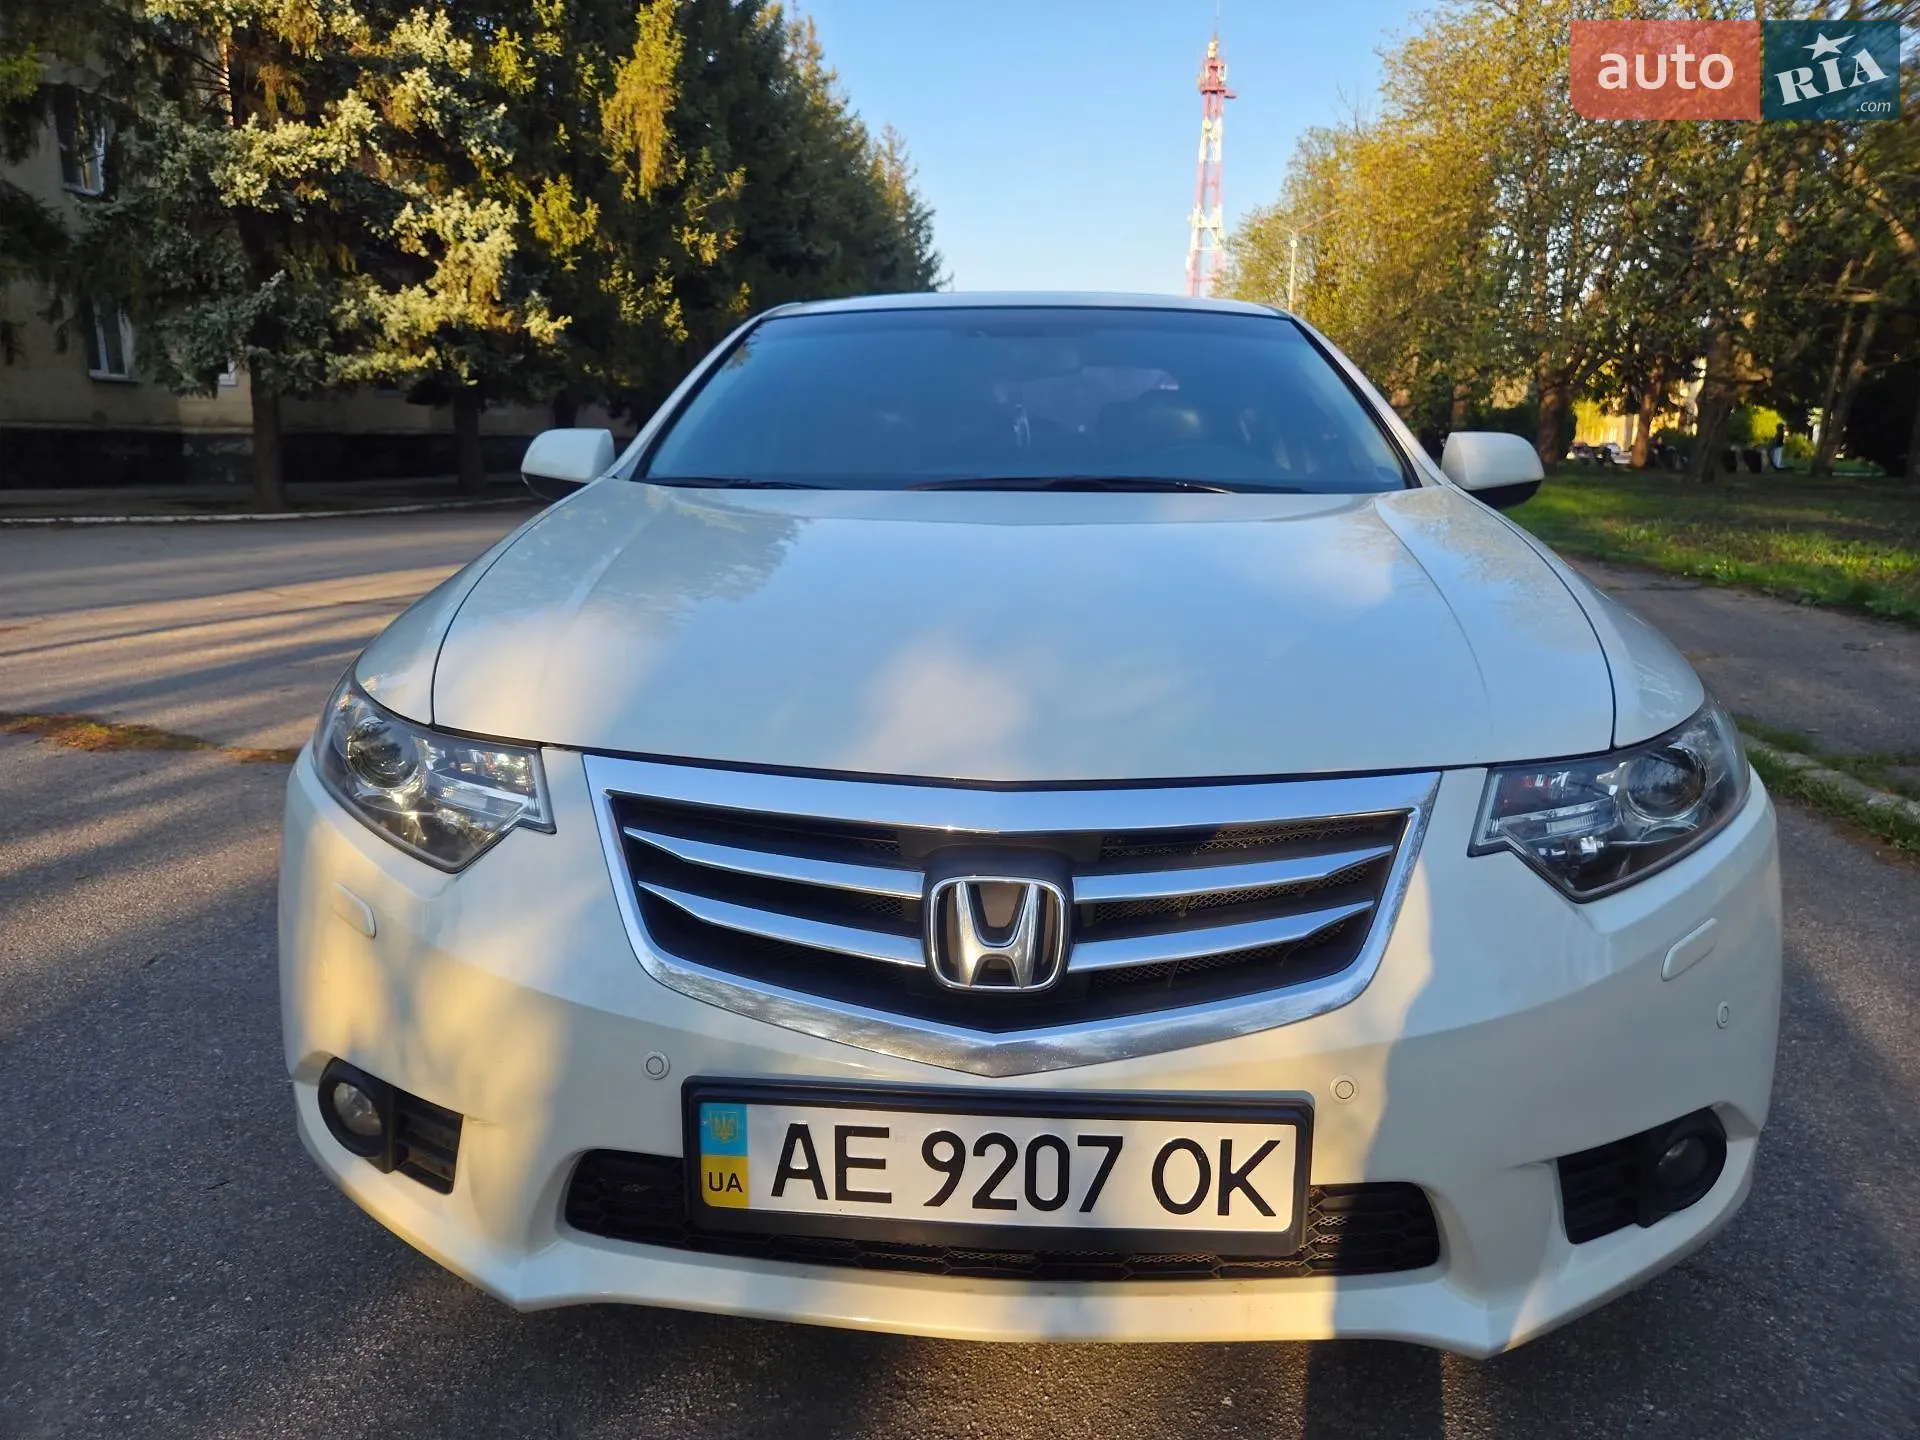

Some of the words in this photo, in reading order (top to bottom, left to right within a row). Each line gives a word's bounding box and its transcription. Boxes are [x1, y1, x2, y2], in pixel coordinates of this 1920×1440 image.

[709, 1172, 743, 1193] UA
[770, 1123, 893, 1204] AE
[921, 1130, 1124, 1213] 9207
[1151, 1137, 1281, 1217] OK
